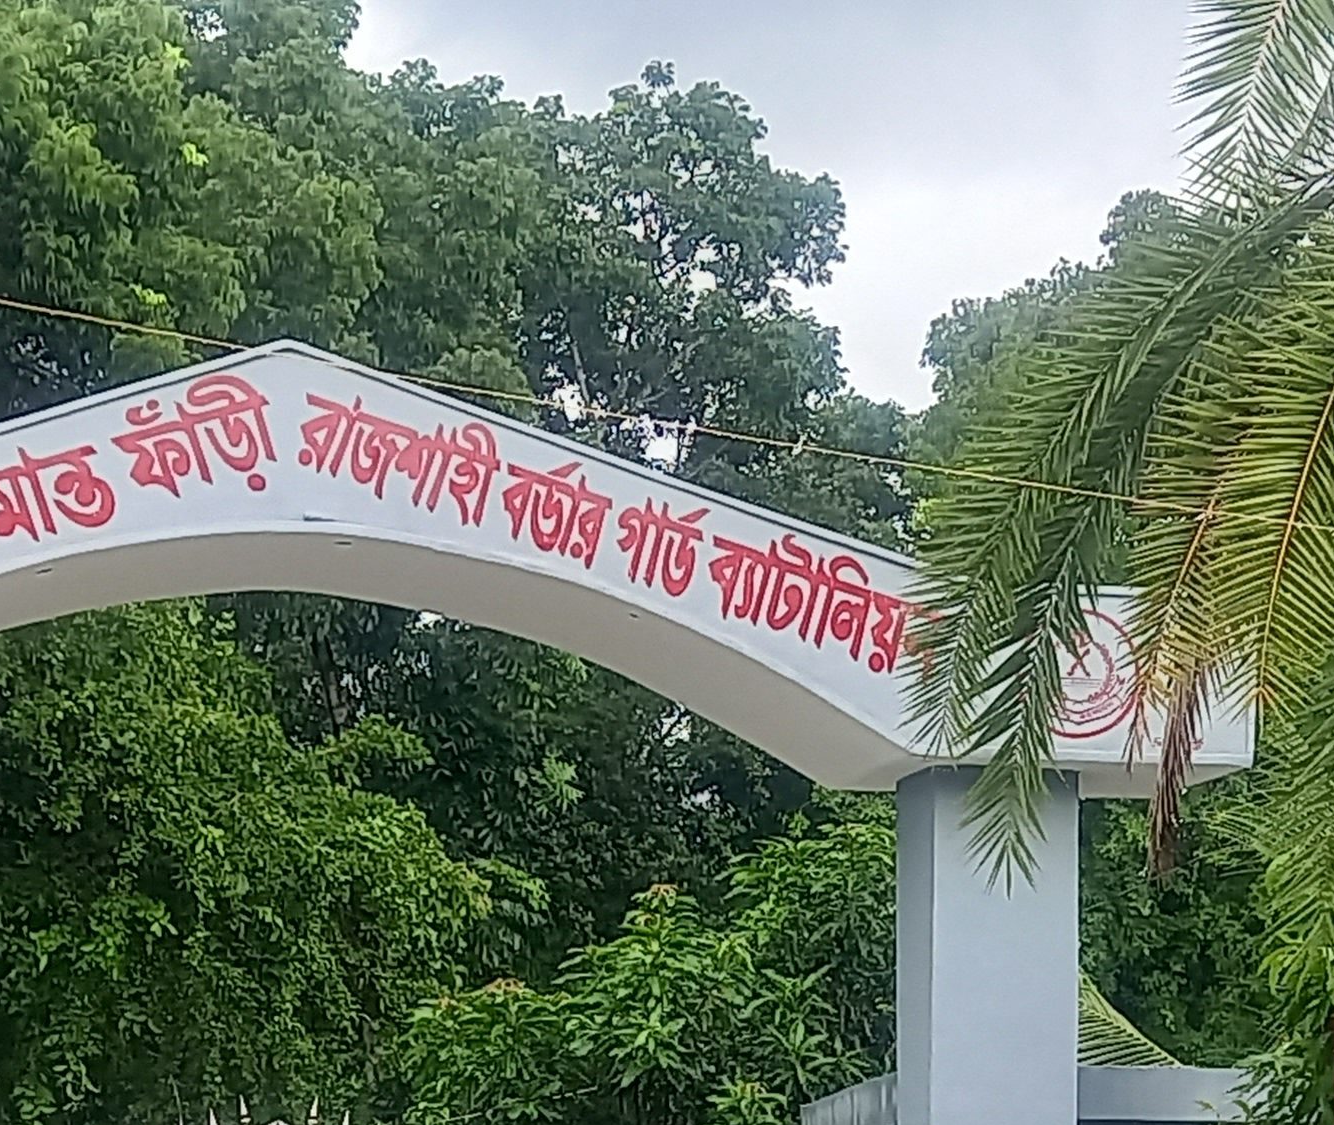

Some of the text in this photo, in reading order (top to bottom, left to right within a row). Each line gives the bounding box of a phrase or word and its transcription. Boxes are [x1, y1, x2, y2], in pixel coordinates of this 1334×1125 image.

[110, 375, 278, 498] ফাঁড়ী
[298, 393, 500, 528] রাজশাহী
[503, 461, 613, 570] বর্ডার
[617, 497, 711, 597] গার্ড
